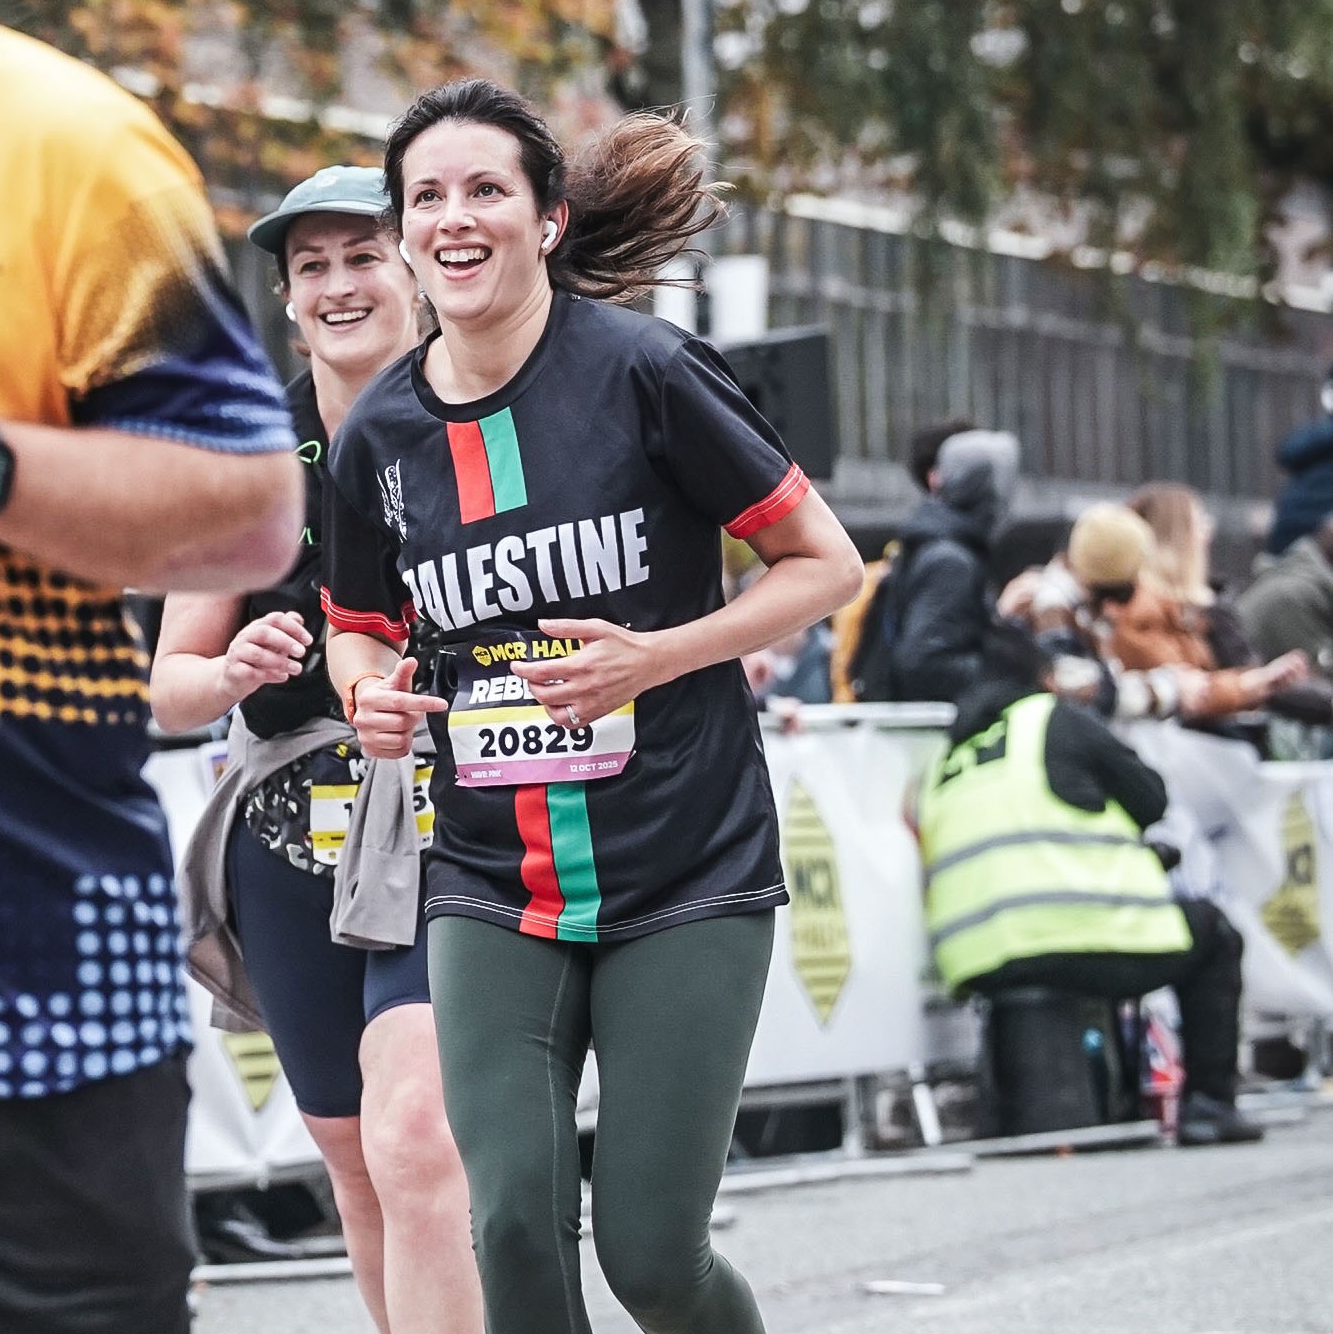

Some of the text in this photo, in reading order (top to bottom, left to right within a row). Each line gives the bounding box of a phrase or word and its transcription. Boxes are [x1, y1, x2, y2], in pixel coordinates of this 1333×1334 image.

[402, 508, 649, 632] PALESTINE
[489, 638, 584, 662] MCR HAL
[478, 724, 594, 758] 20829
[578, 763, 596, 772] OCT
[597, 760, 619, 770] 2025
